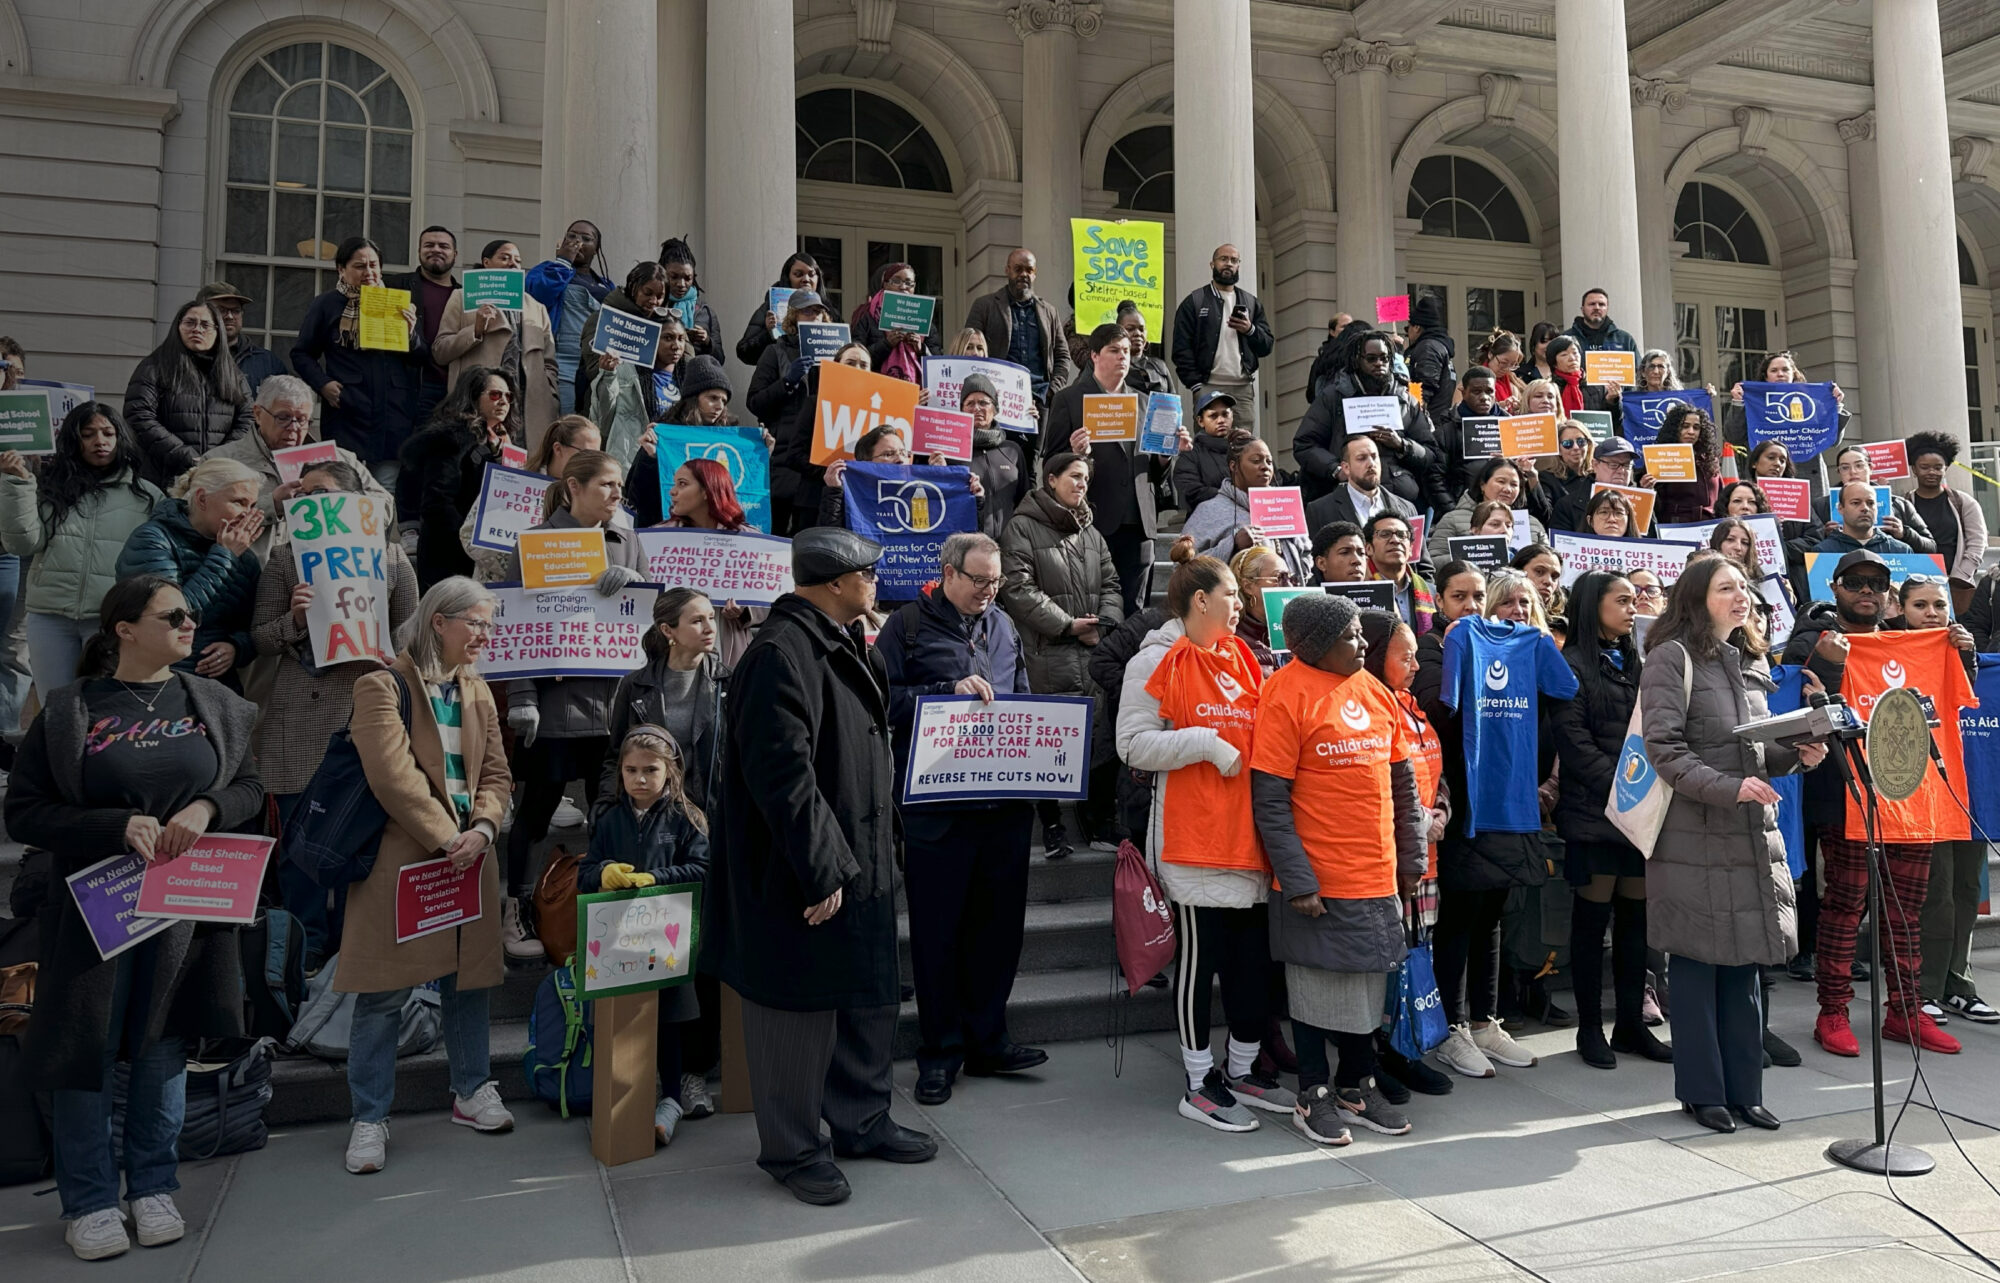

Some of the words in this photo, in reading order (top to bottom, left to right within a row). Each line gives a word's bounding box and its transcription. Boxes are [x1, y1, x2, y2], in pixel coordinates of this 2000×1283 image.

[1082, 226, 1148, 260] Save
[1085, 282, 1147, 299] Shelter-based
[884, 313, 906, 321] Success
[612, 315, 624, 326] We
[624, 320, 647, 334] Need
[604, 325, 650, 346] Community
[822, 328, 840, 337] Need
[608, 338, 640, 353] Schools
[807, 337, 845, 346] Community
[1008, 403, 1024, 412] AND
[1765, 391, 1816, 423] 50
[11, 410, 40, 418] School
[935, 425, 953, 434] Based
[493, 489, 509, 499] UP
[513, 493, 531, 504] TO
[506, 502, 530, 514] FOR
[877, 479, 946, 533] 50
[290, 496, 352, 540] 3K
[358, 497, 378, 536] &
[559, 540, 582, 548] Need
[911, 544, 924, 552] for
[526, 552, 569, 560] Preschool
[570, 550, 601, 559] Special
[662, 546, 724, 557] FAMILIES
[729, 550, 773, 561] CAN'T
[887, 555, 897, 563] of
[899, 555, 920, 563] New
[922, 555, 941, 563] York
[1581, 547, 1621, 557] BUDGET
[1625, 550, 1653, 559] CUTS
[544, 562, 587, 570] Education
[650, 556, 695, 566] FFORD
[701, 558, 721, 567] TO
[725, 559, 755, 570] LIVE
[758, 562, 791, 574] HERE
[1573, 554, 1588, 562] TO
[1625, 560, 1653, 568] LOST
[649, 565, 720, 578] ANYMORE.
[724, 570, 782, 582] REVERSE
[904, 566, 923, 577] every
[1569, 562, 1588, 570] FOR
[1656, 570, 1679, 578] AND
[688, 577, 709, 587] TO
[713, 579, 738, 589] ECE
[743, 580, 782, 592] NOW!
[335, 586, 375, 619] for
[536, 594, 587, 605] Campaign
[536, 604, 550, 614] for
[554, 603, 596, 614] Children
[495, 622, 553, 636] EVERSE
[560, 622, 588, 632] THE
[595, 623, 640, 634] CUTS!
[325, 620, 385, 662] ALL
[559, 634, 602, 645] PRE-K
[608, 636, 639, 646] AND
[488, 650, 513, 662] 3-K
[519, 647, 591, 659] FUNDING
[596, 648, 638, 659] NOW!
[1515, 697, 1529, 708] Aid
[949, 713, 994, 724] BUDGET
[999, 713, 1033, 723] CUTS
[1978, 717, 1999, 728] Aid
[923, 727, 937, 737] UP
[940, 726, 955, 736] TO
[958, 725, 994, 736] 15,000
[998, 725, 1032, 735] LOST
[1036, 726, 1079, 737] SEATS
[134, 740, 159, 748] LTW
[933, 738, 953, 748] FOR
[957, 737, 993, 747] EARLY
[998, 736, 1030, 746] CARE
[1035, 738, 1063, 748] AND
[1316, 734, 1384, 756] Children's
[954, 748, 1031, 759] EDUCATION.
[1329, 757, 1352, 766] Every
[918, 772, 966, 785] REVERSE
[970, 772, 993, 782] THE
[997, 772, 1032, 782] CUTS
[1036, 773, 1073, 784] NOW!
[214, 848, 258, 861] Shelter-
[190, 861, 224, 873] Based
[87, 877, 106, 890] We
[106, 860, 137, 881] Need
[408, 875, 421, 883] We
[421, 867, 442, 881] Need
[167, 875, 239, 890] Coordinators
[415, 878, 450, 893] Programs
[451, 873, 465, 882] and
[419, 887, 460, 903] Translation
[424, 899, 455, 913] Services
[619, 931, 651, 948] our
